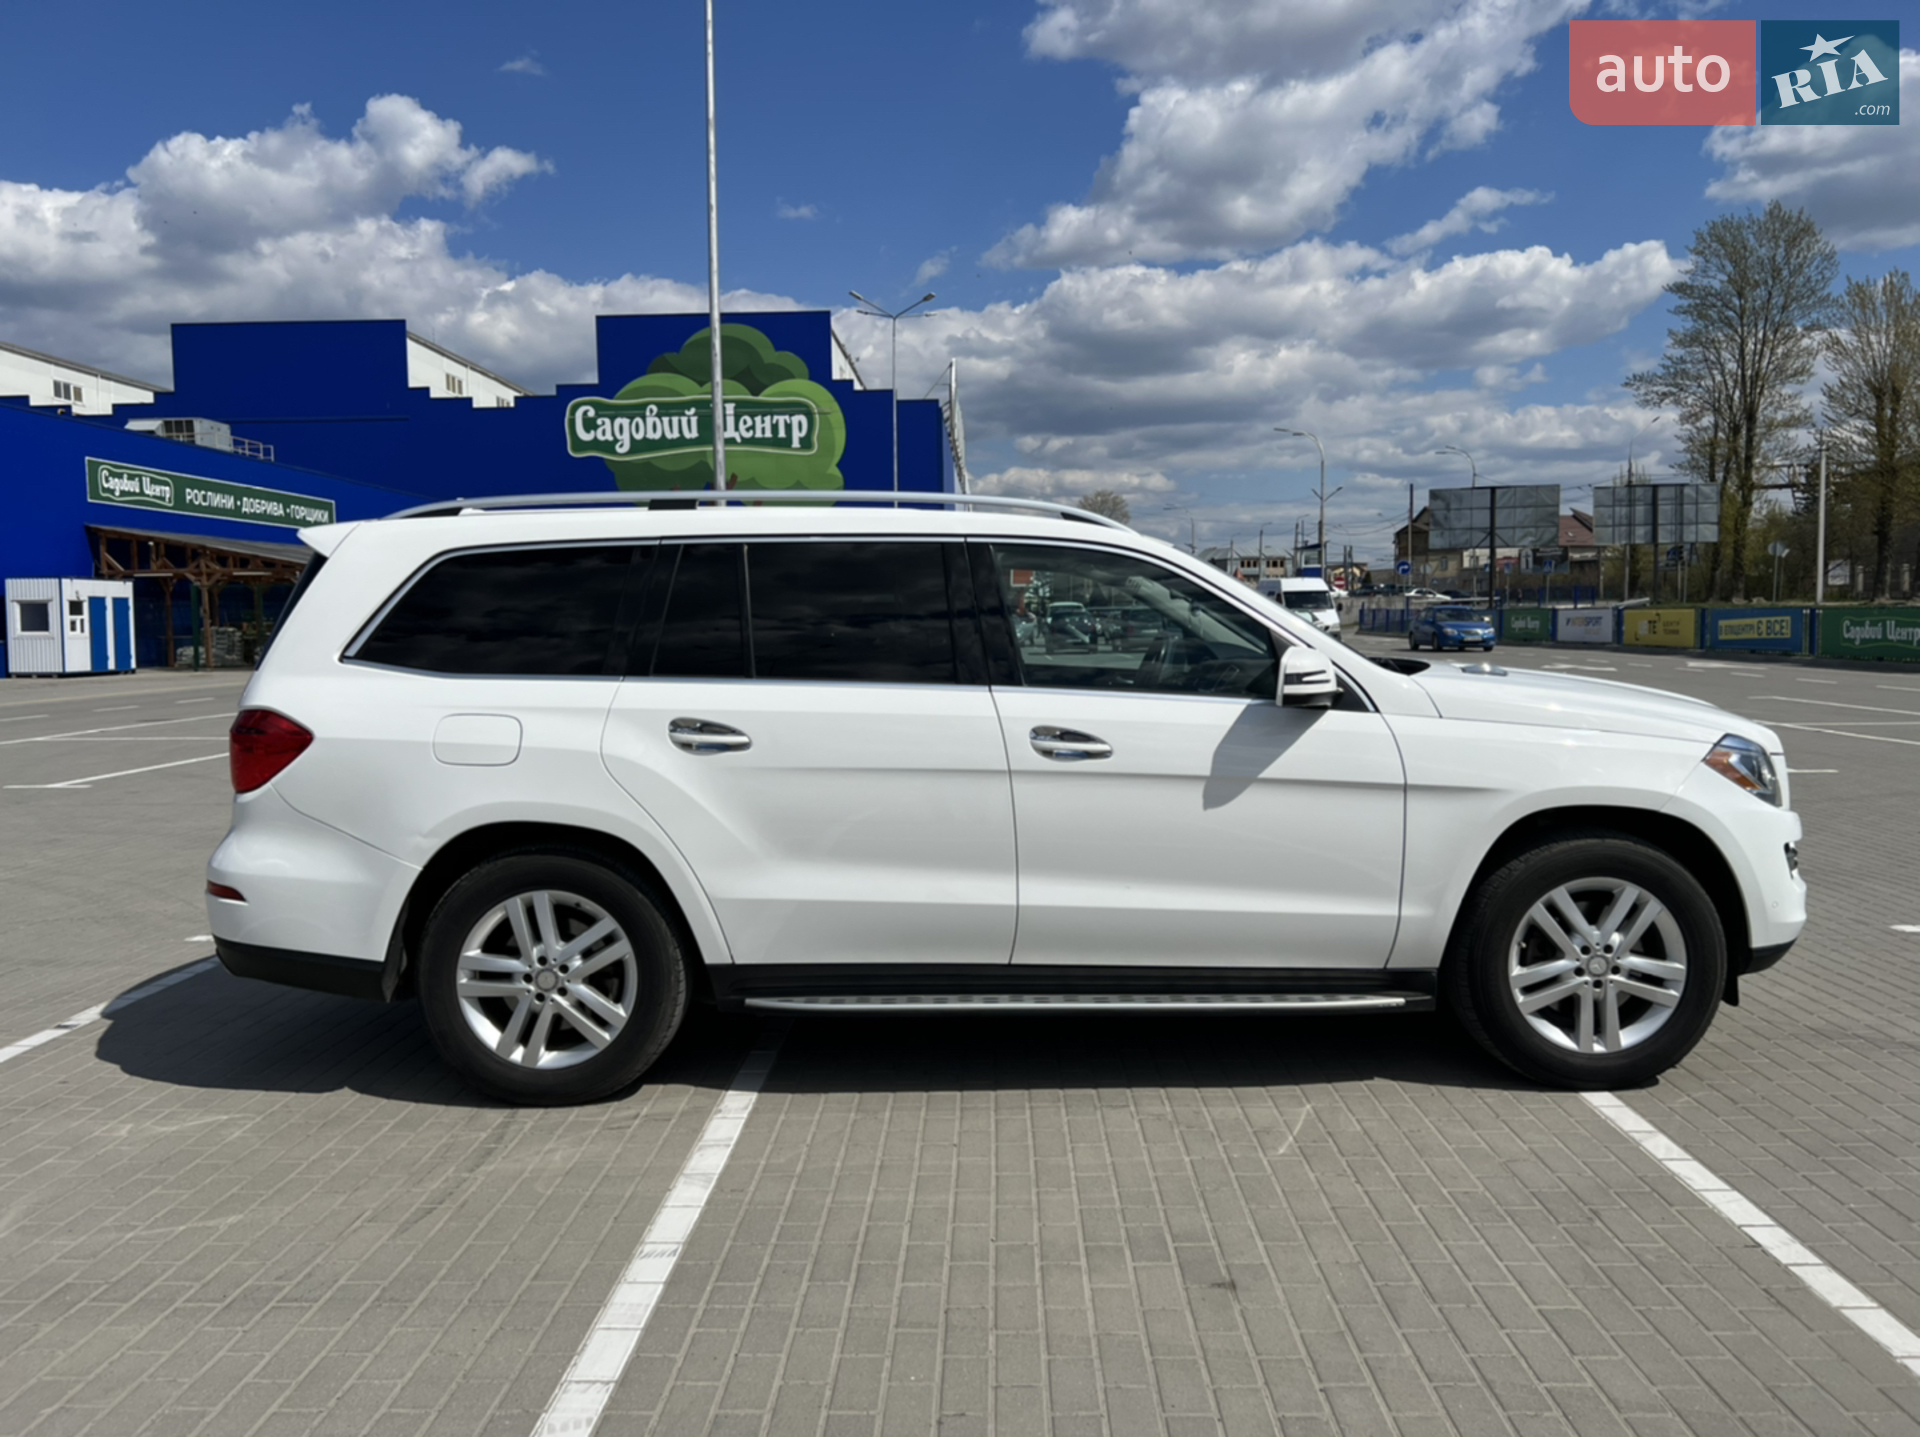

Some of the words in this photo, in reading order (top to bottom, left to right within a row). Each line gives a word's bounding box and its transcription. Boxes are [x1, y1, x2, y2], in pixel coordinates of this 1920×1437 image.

[575, 403, 699, 454] Садовий
[711, 402, 809, 448] Центр
[101, 470, 140, 496] Садовий
[142, 476, 171, 502] Центр
[185, 488, 235, 510] РОСЛИНИ
[242, 497, 285, 517] ДОБРИВА
[290, 504, 330, 523] ГОРЩИКИ
[1766, 619, 1789, 636] ВСЕ!
[1843, 620, 1882, 645] Садовий
[1886, 620, 1920, 646] Центр
